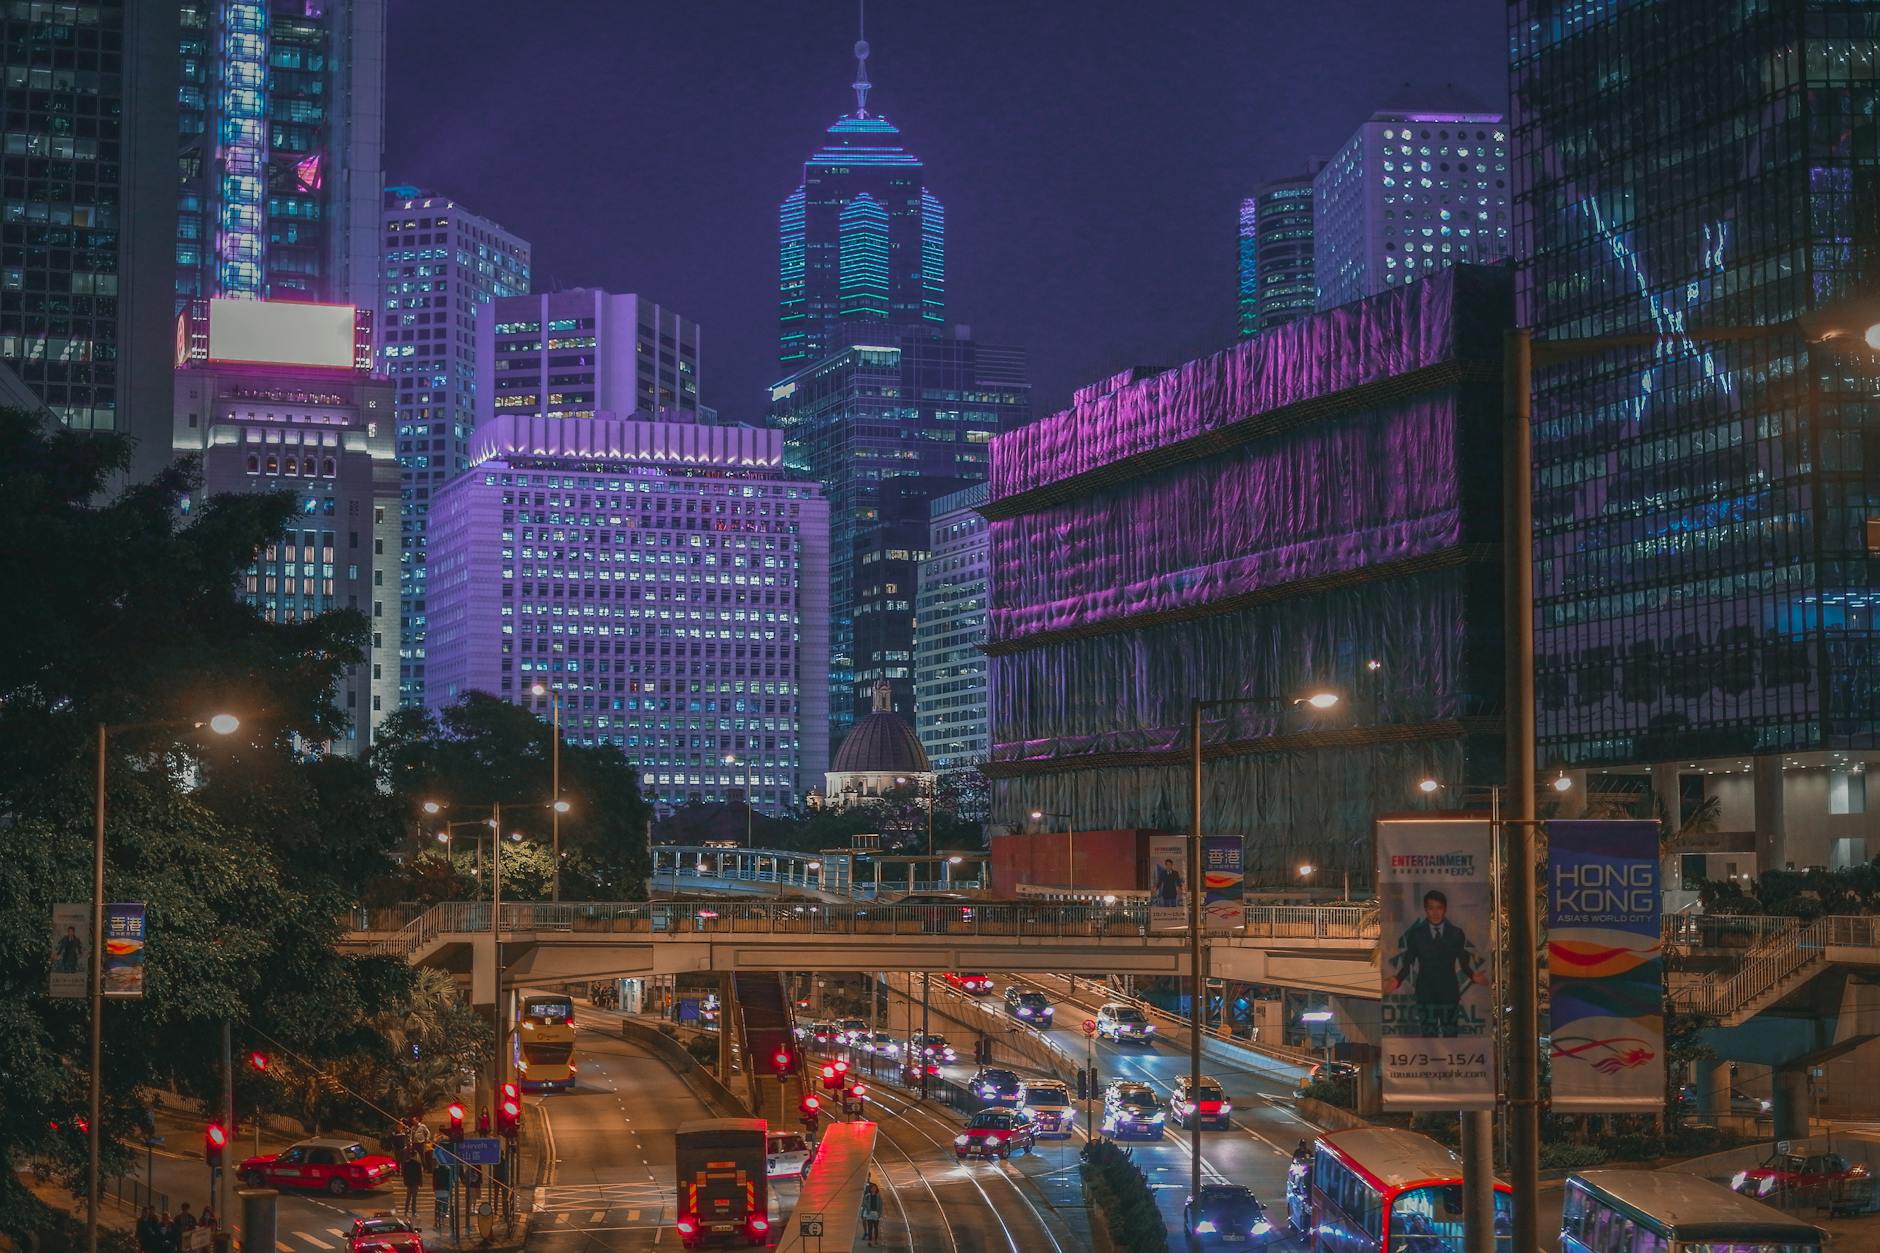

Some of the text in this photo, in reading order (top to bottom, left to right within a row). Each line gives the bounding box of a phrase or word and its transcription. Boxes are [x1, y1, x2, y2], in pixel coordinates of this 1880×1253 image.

[1208, 848, 1240, 864] 香港
[1391, 855, 1473, 867] ENTERTAINMENT
[1556, 864, 1652, 887] HONG
[1556, 889, 1653, 912] KONG
[110, 916, 142, 932] 香港
[1557, 914, 1653, 922] ASIA'S WORLD CITY
[1381, 1004, 1486, 1024] DIGITAL
